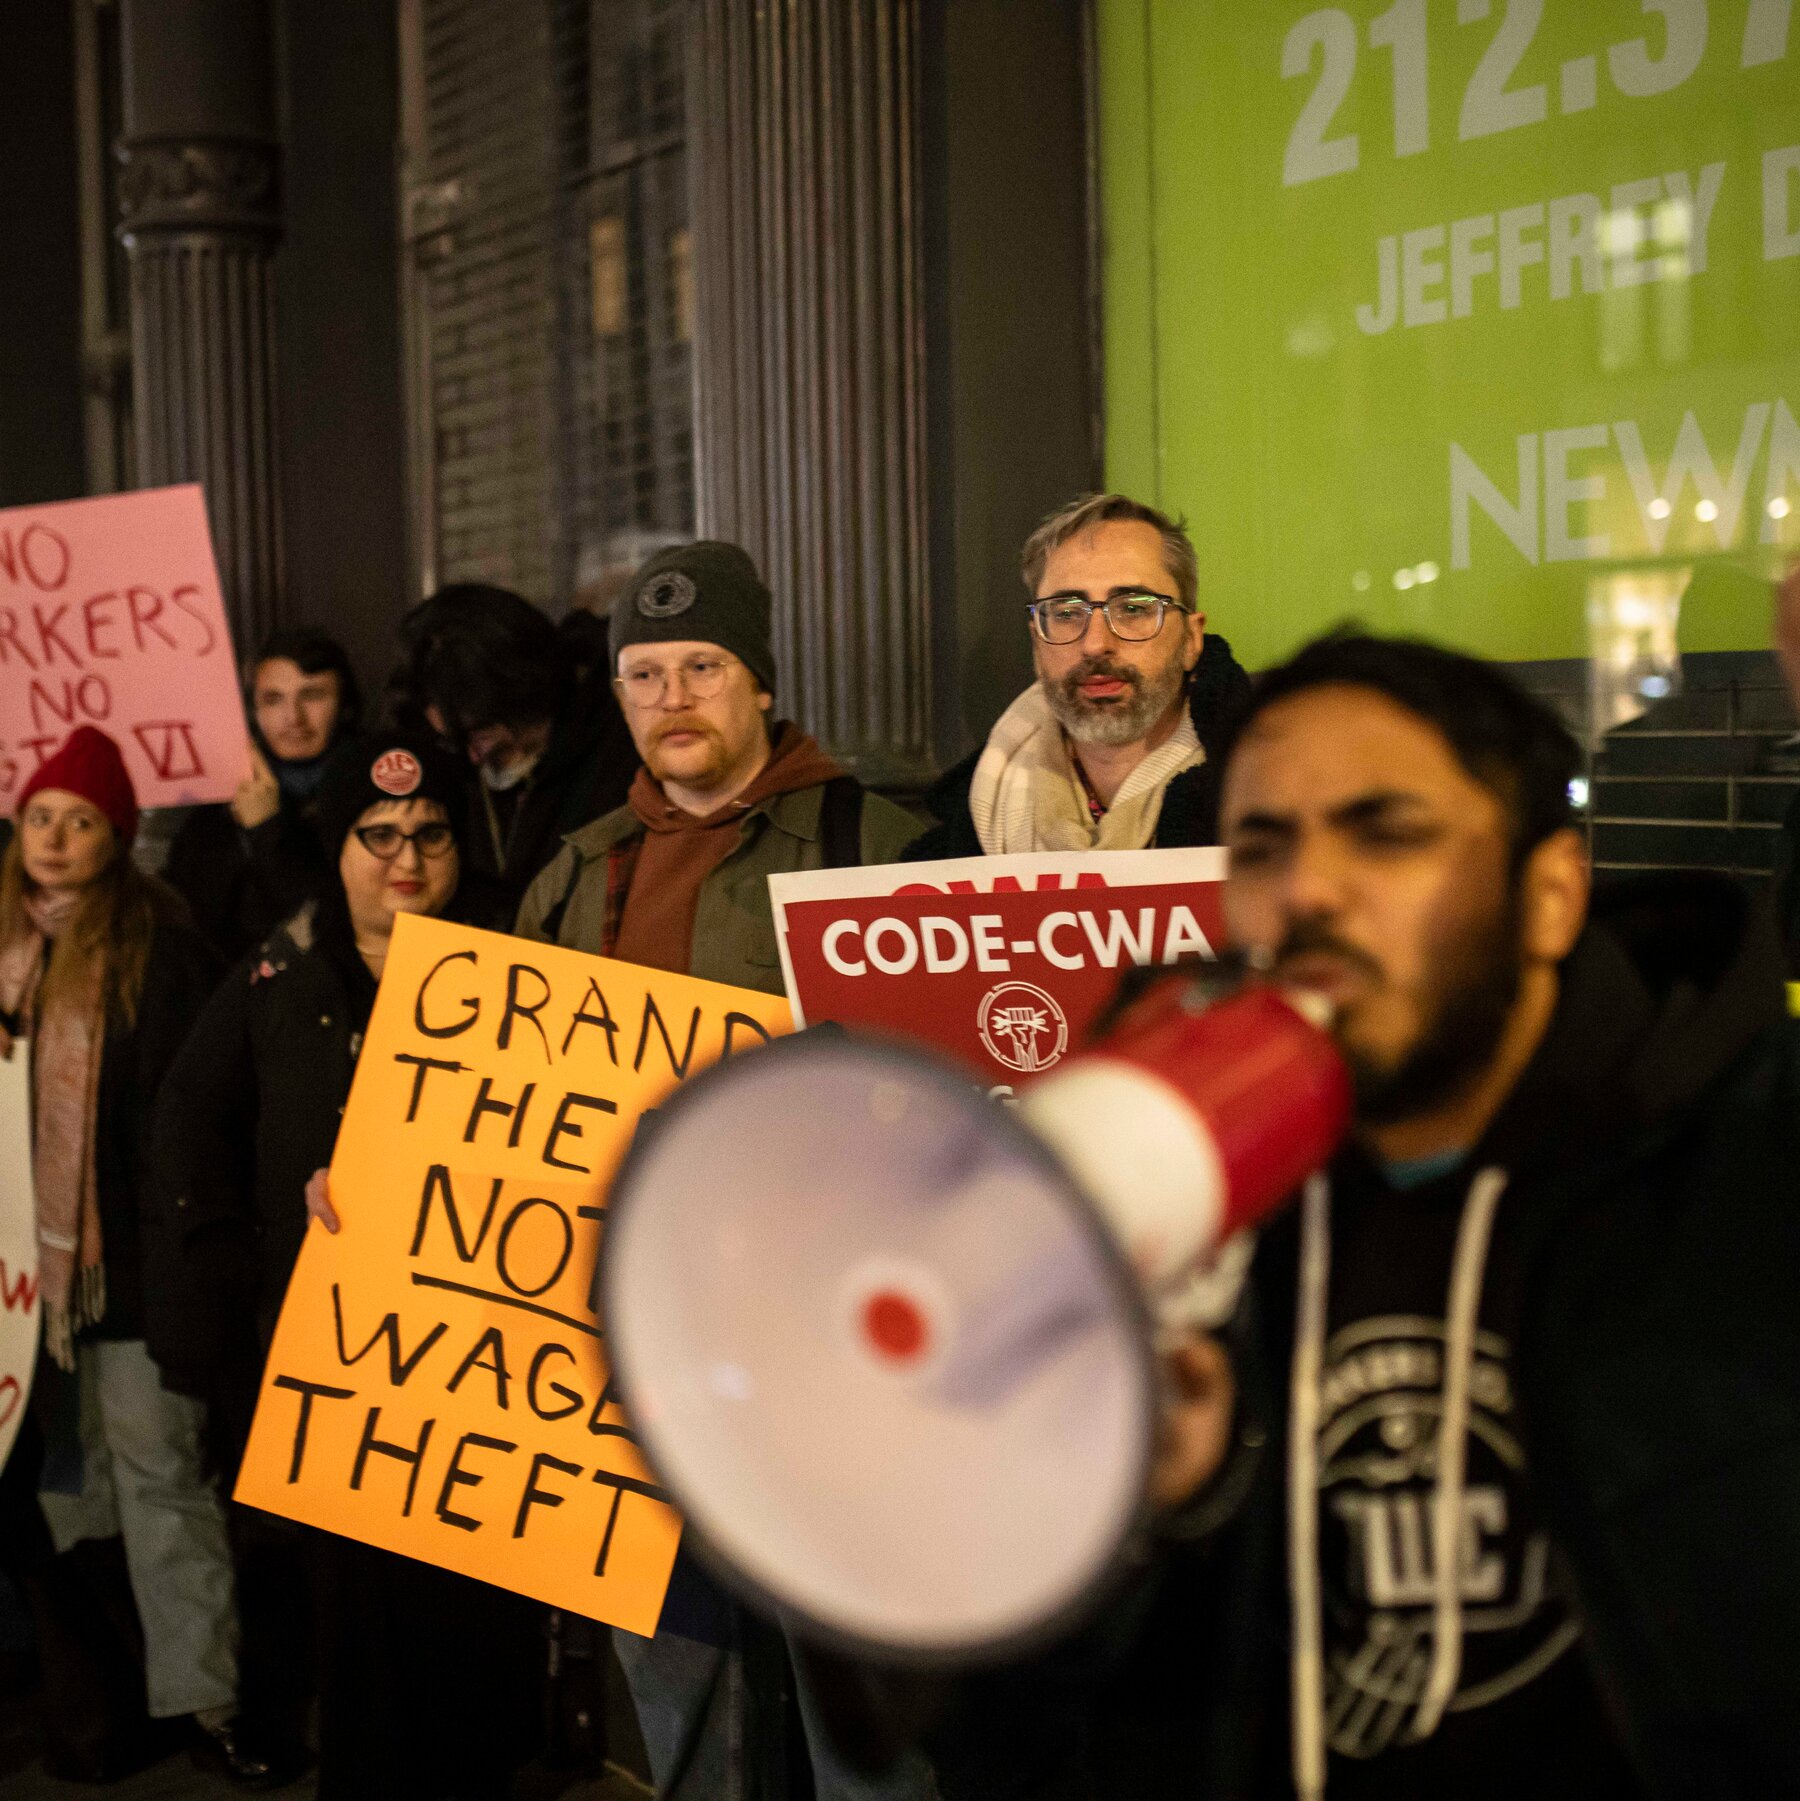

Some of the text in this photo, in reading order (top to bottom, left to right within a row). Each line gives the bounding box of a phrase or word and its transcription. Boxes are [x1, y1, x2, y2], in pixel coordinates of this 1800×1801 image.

[1355, 161, 1727, 335] JEFFREY
[29, 673, 112, 732] NO
[822, 905, 1218, 977] CODE-CWA
[394, 1053, 618, 1174] THE
[273, 1375, 675, 1577] THEFT
